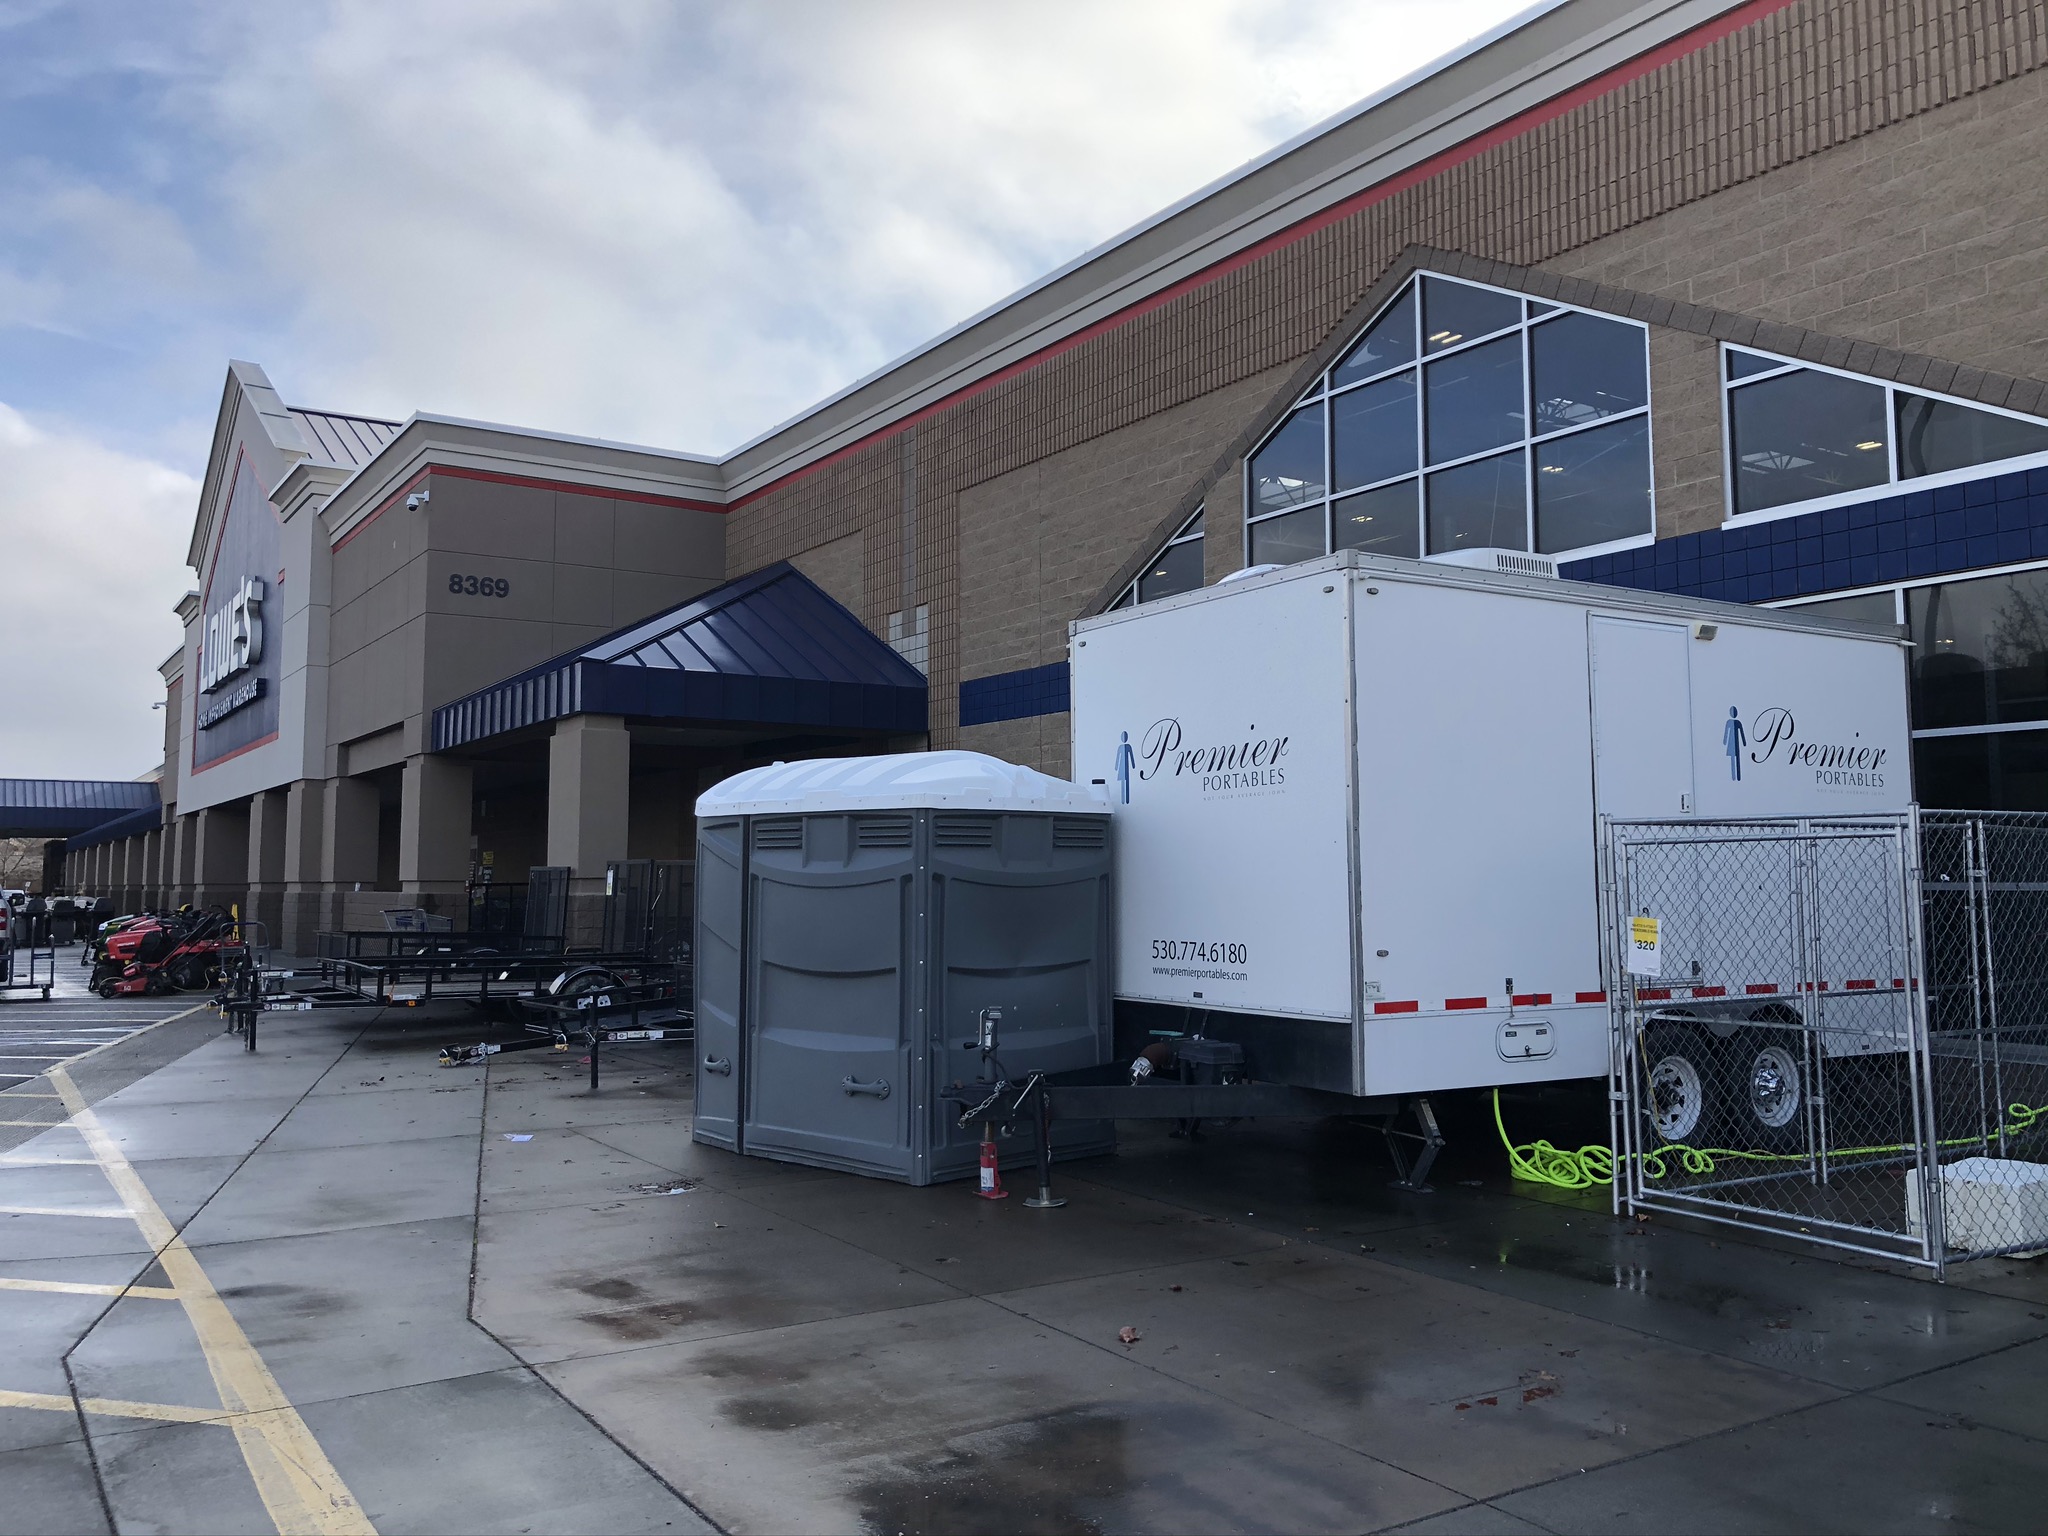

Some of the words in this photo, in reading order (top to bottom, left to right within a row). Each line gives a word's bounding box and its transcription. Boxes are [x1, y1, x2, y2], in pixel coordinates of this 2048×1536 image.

[449, 573, 510, 598] 8369
[200, 575, 257, 694] LOWE'S
[1140, 717, 1290, 780] Premier
[1751, 707, 1887, 770] Premier
[1203, 768, 1285, 791] PORTABLES
[1816, 770, 1885, 787] PORTABLES
[1152, 940, 1248, 964] 530.774.6180
[1152, 966, 1248, 981] www.premierportables.com
